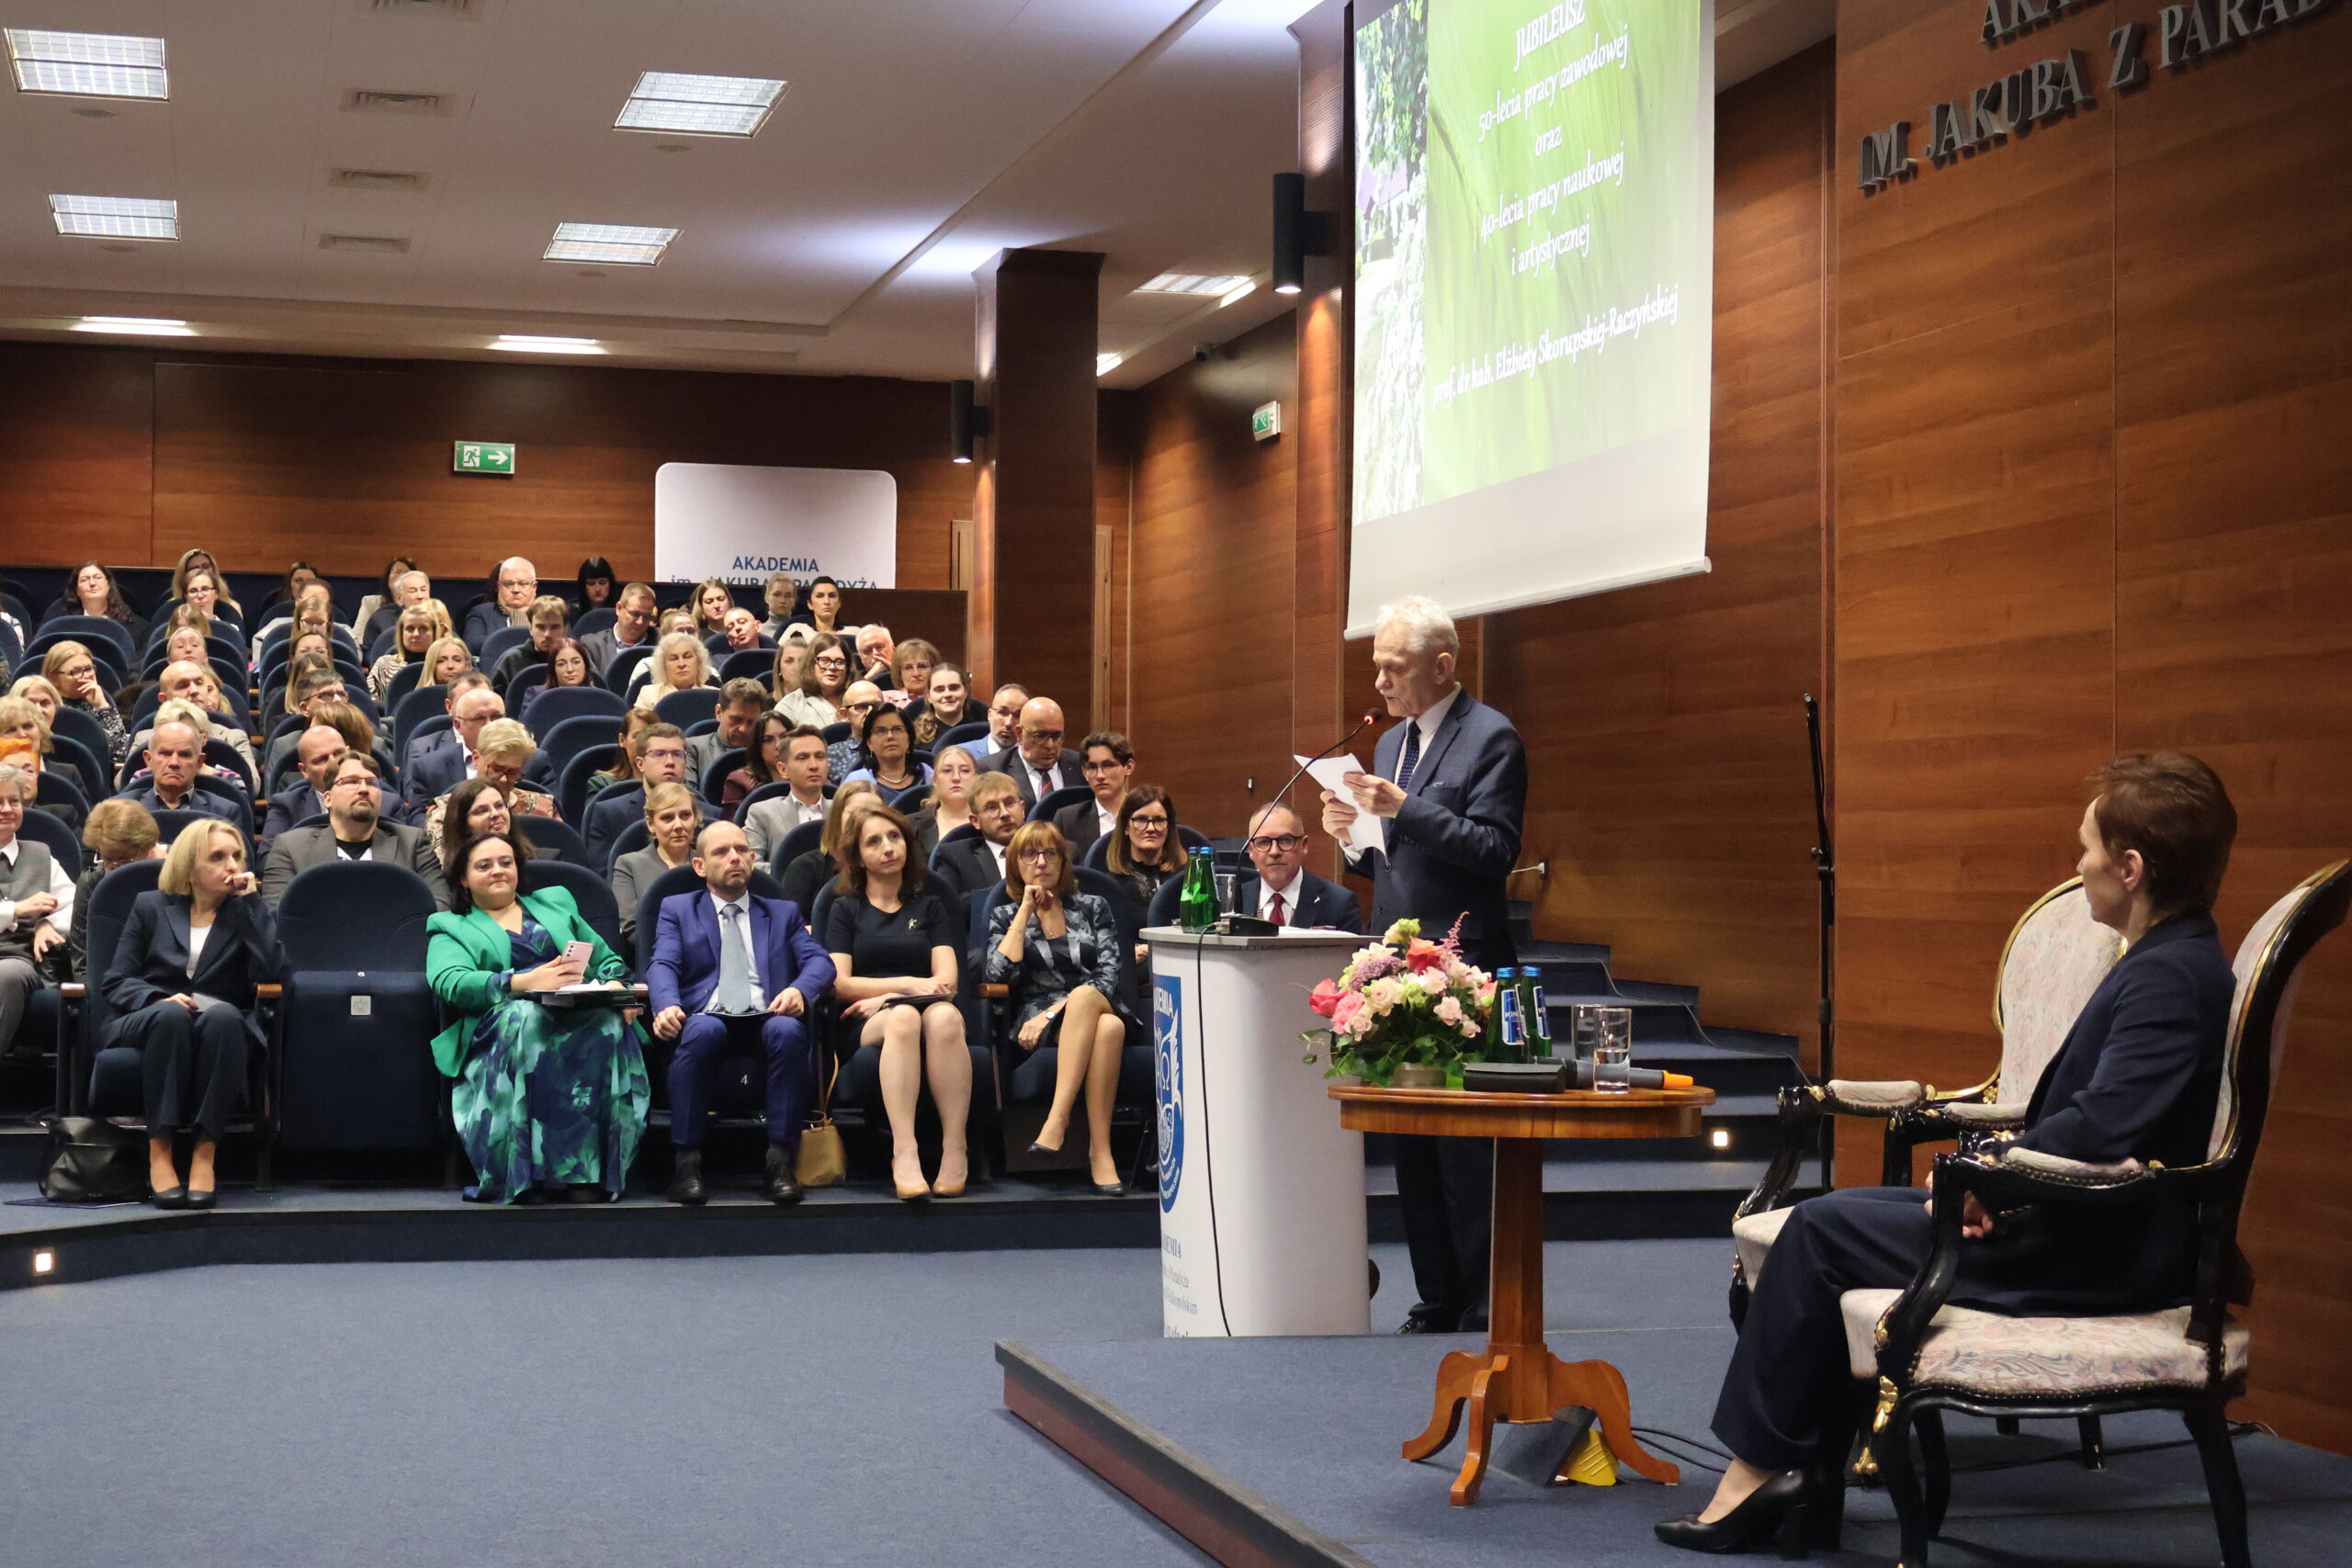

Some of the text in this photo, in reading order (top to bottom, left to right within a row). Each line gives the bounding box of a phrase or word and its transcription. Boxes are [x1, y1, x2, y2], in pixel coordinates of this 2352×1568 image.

[1513, 0, 1586, 72] JUBILEUSZ
[1976, 0, 2078, 44] AK
[1478, 23, 1628, 142] 50-lecia pracy zawodowej
[1926, 49, 2096, 160] JAKUBA
[2108, 23, 2148, 88] Z
[2157, 0, 2322, 69] PARA
[1535, 125, 1562, 156] oraz
[1480, 141, 1623, 243] 40-lecia pracy naukowej
[1511, 212, 1590, 278] i artystycznej
[1432, 282, 1679, 414] prof. dr hab. Elżbiety Skorupskiej-Raczyńskiej
[732, 556, 820, 572] AKADEMIA
[741, 1074, 749, 1086] 4
